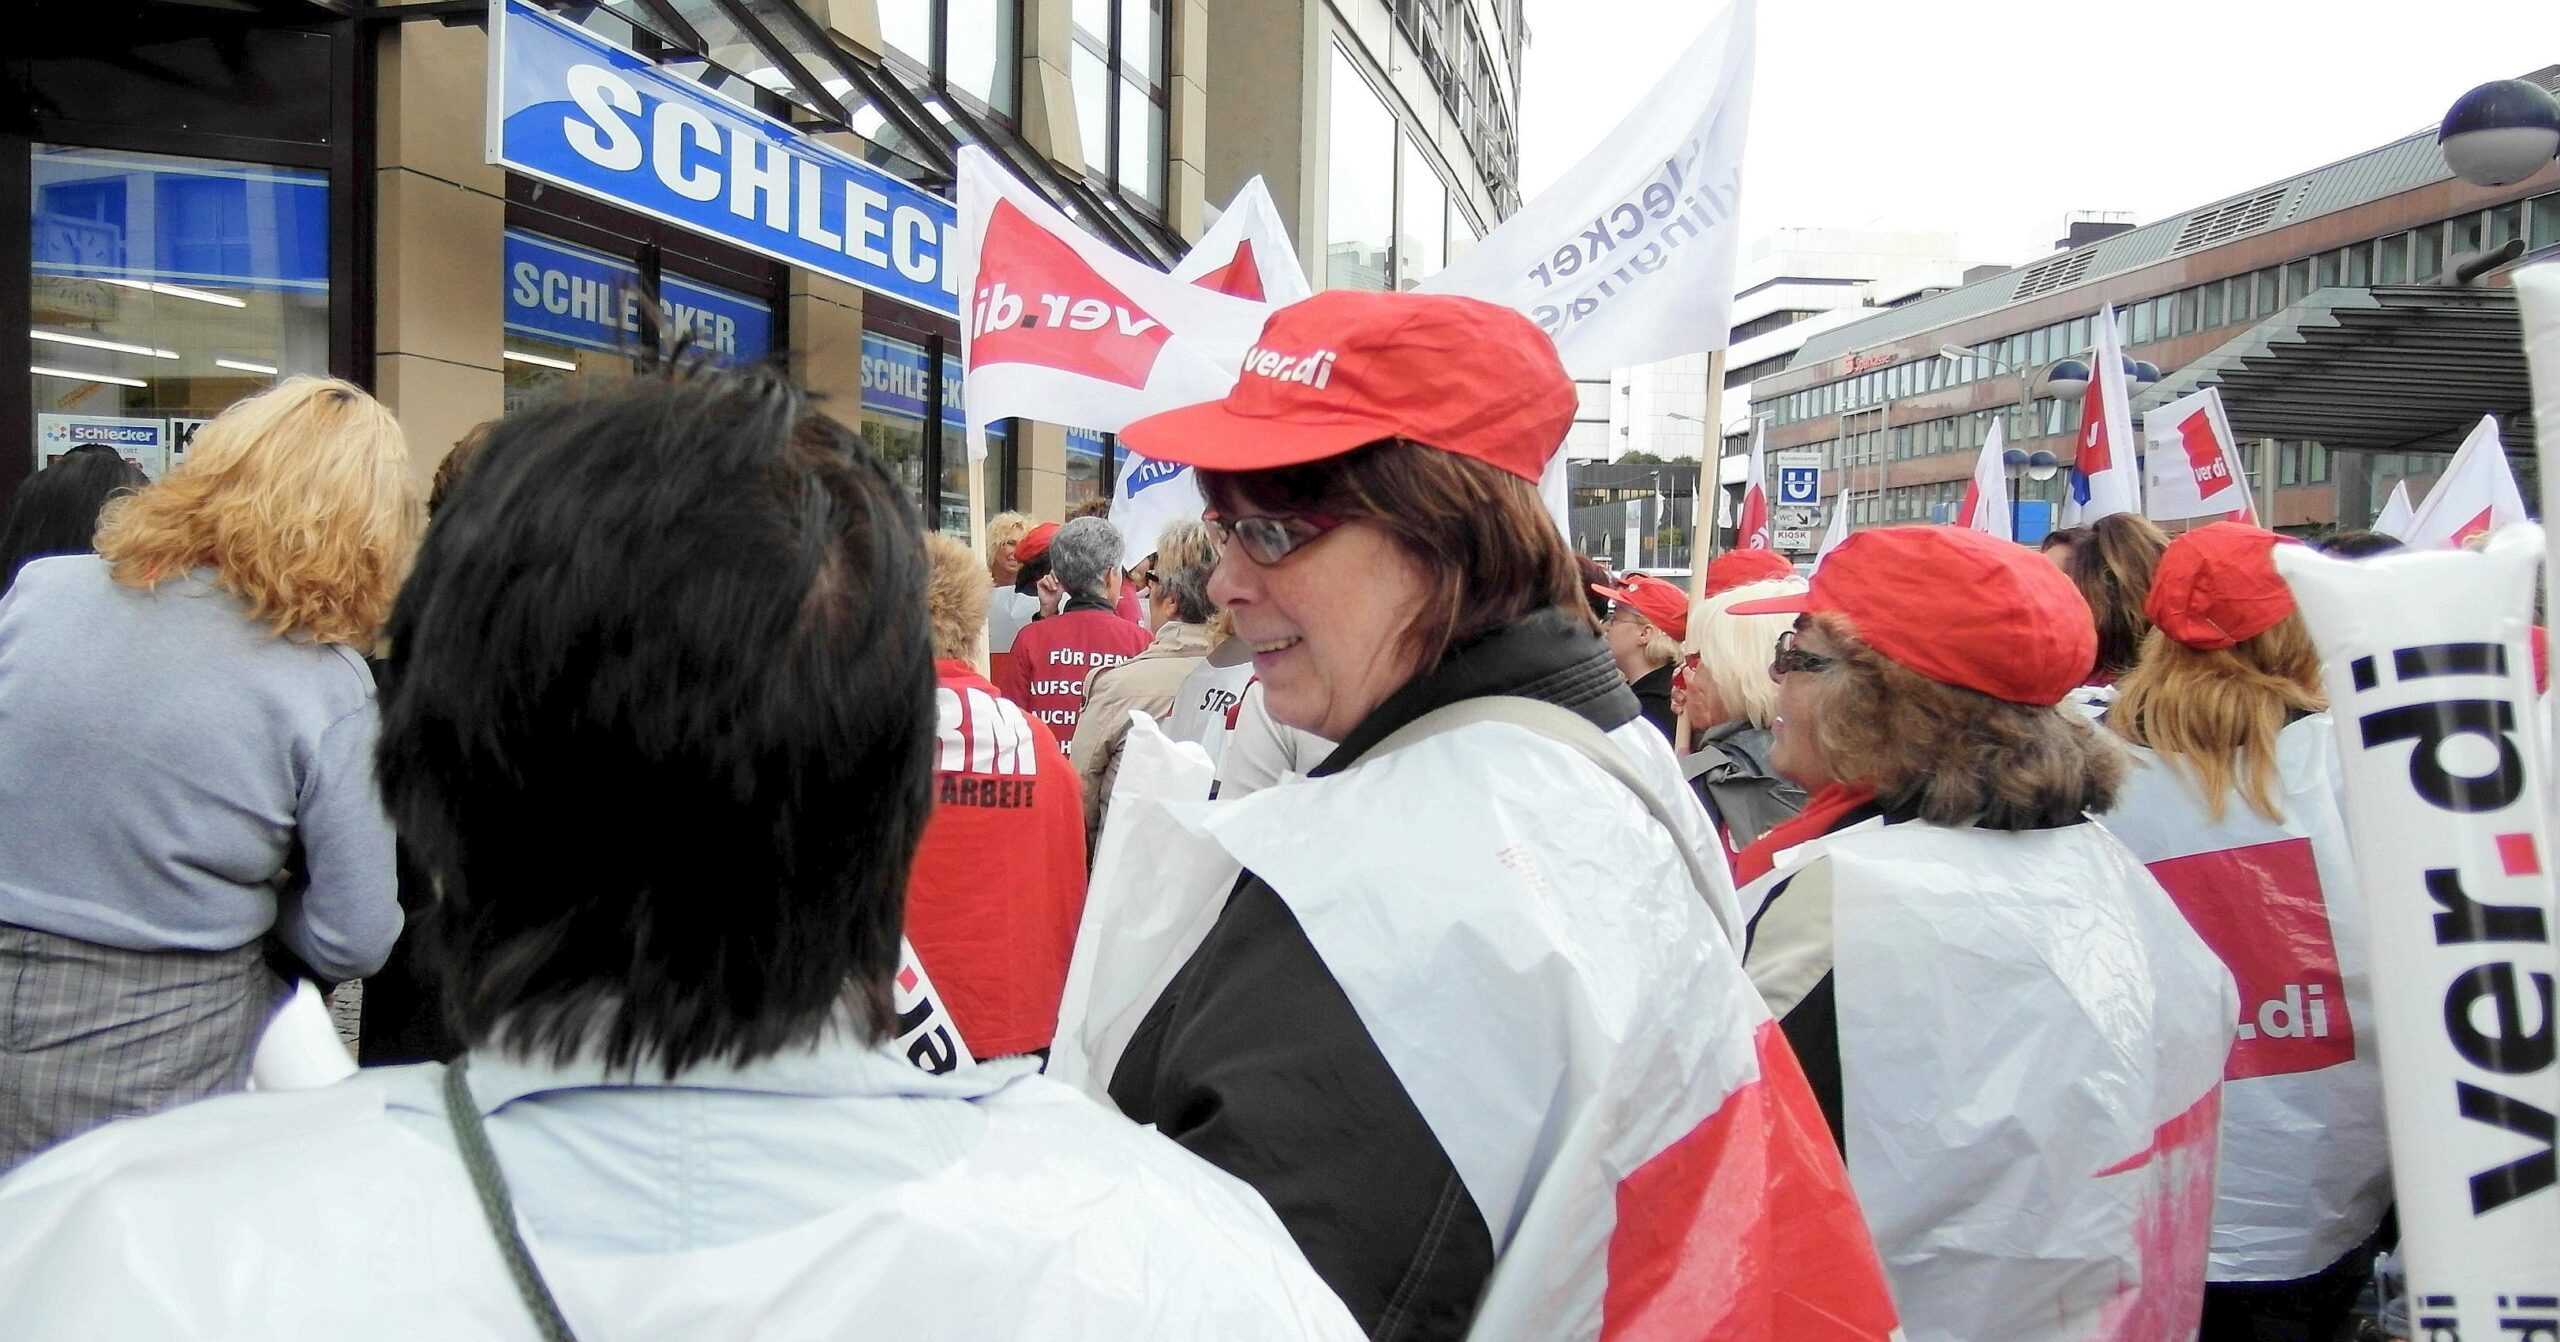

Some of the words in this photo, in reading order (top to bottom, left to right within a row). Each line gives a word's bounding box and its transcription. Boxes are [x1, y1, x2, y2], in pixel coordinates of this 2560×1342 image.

[1244, 348, 1337, 390] ver.di
[74, 427, 154, 442] Schlecker
[1777, 531, 1807, 539] KIOSK
[1050, 648, 1084, 665] FÜR
[1089, 652, 1127, 667] DEN
[1030, 680, 1086, 696] UFSC
[1199, 687, 1238, 712] STR
[934, 686, 1038, 776] RM
[940, 775, 1036, 809] ARBEIT
[2350, 642, 2558, 1217] ver.di
